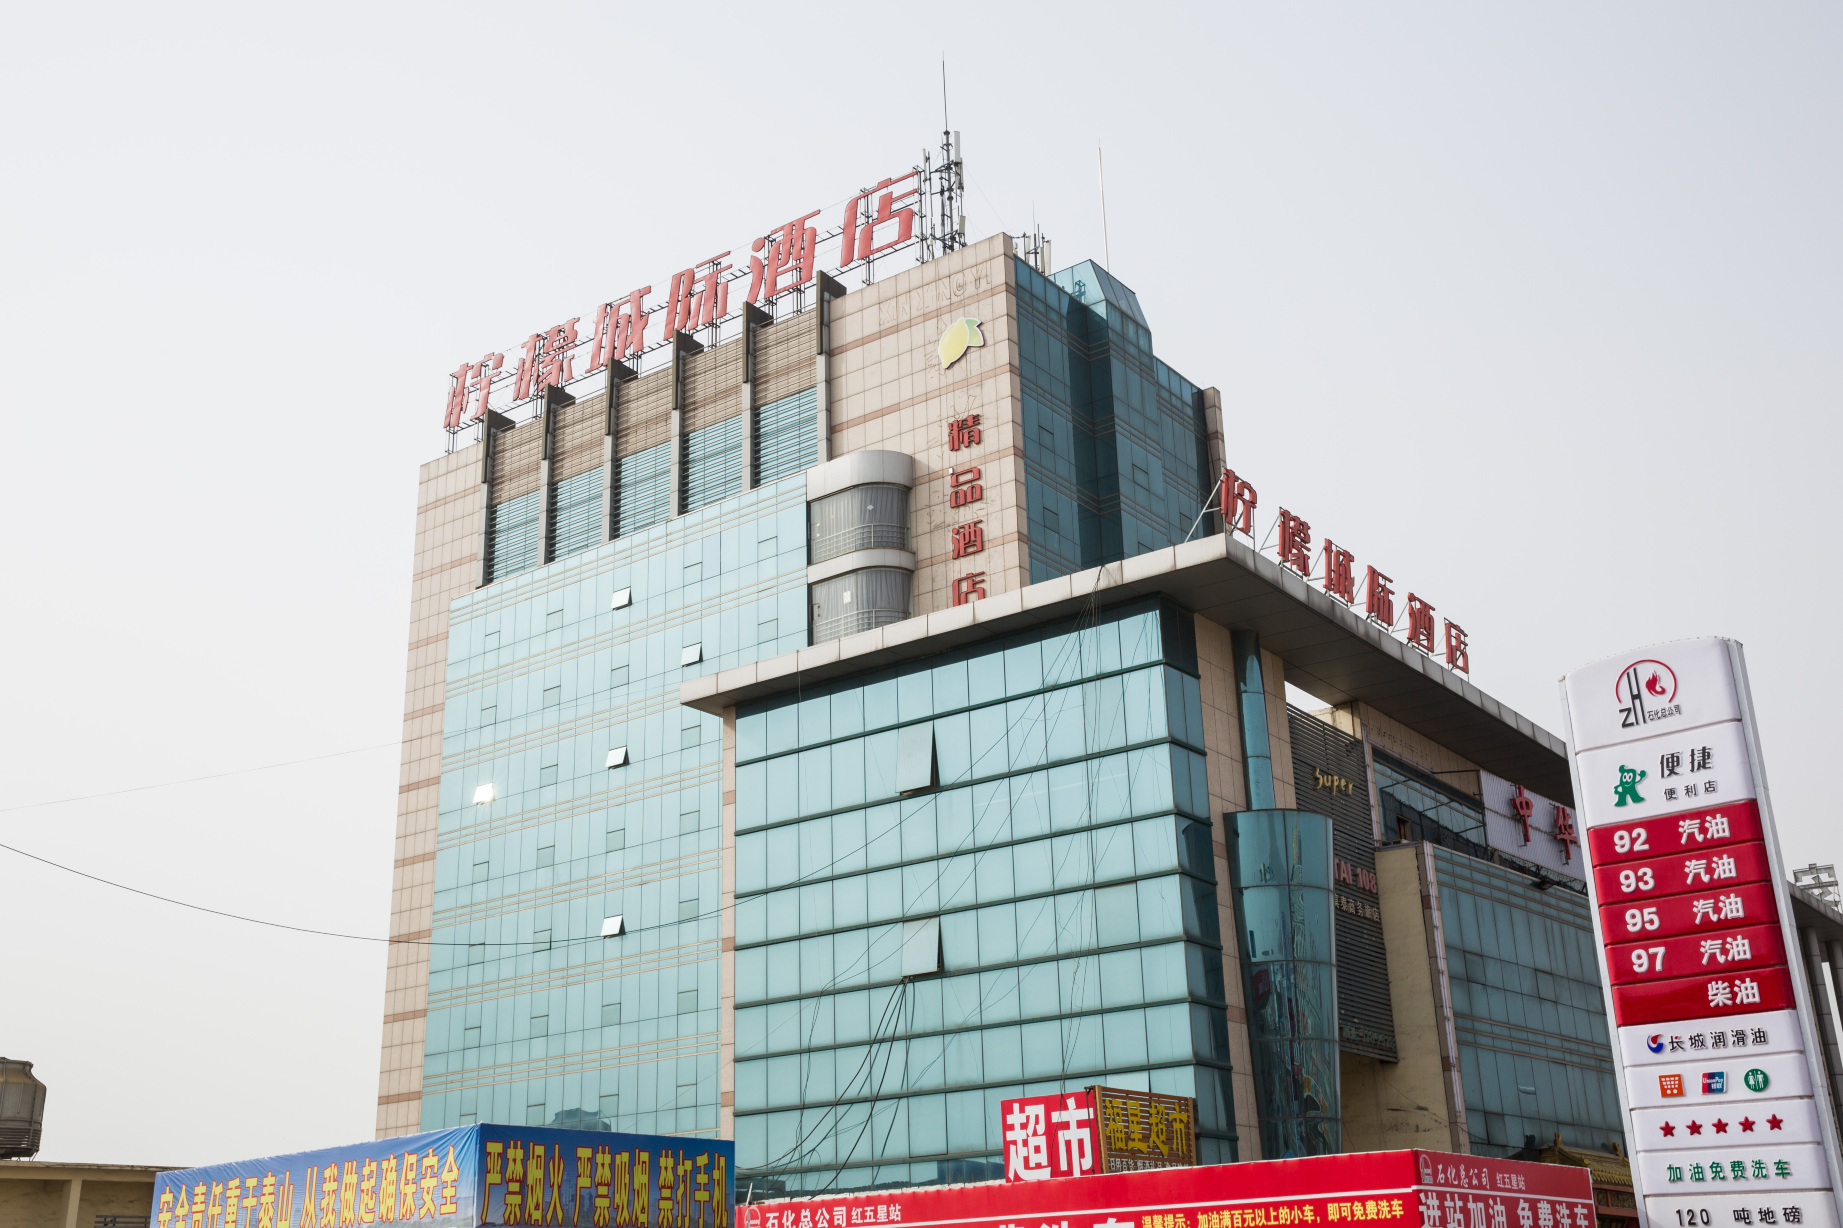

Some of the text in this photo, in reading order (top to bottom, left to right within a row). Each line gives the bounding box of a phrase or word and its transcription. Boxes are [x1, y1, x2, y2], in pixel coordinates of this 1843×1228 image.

[443, 171, 919, 430] 柠檬城际酒店
[948, 413, 986, 607] 精品酒店
[1647, 704, 1682, 721] 石化总公司
[1659, 745, 1714, 778] 便捷
[1314, 767, 1353, 796] Super
[1664, 779, 1718, 801] 便利店
[1613, 813, 1731, 854] 92 汽油
[1356, 867, 1378, 894] 108
[1619, 854, 1738, 894] 93 汽油
[1625, 893, 1744, 933] 95 汽油
[1631, 935, 1752, 973] 97 汽油
[1707, 977, 1761, 1008] 柴油
[1667, 1027, 1768, 1052] 长城润滑油
[1702, 1076, 1724, 1084] UnionPay
[1006, 1095, 1095, 1182] 超市
[1105, 1097, 1188, 1158] 福星超市
[157, 1145, 460, 1228] 安全责任重于泰山 从我做起确保安全
[480, 1139, 729, 1228] 严禁烟火 严禁吸烟 禁打手机
[1437, 1163, 1526, 1191] 石化总公司 红五星站
[1667, 1159, 1791, 1182] 加油免费洗车
[765, 1203, 902, 1228] 石化总公司 红五星站
[1418, 1191, 1589, 1228] 进站加油 免费洗车
[1675, 1205, 1801, 1227] 120 吨地磅
